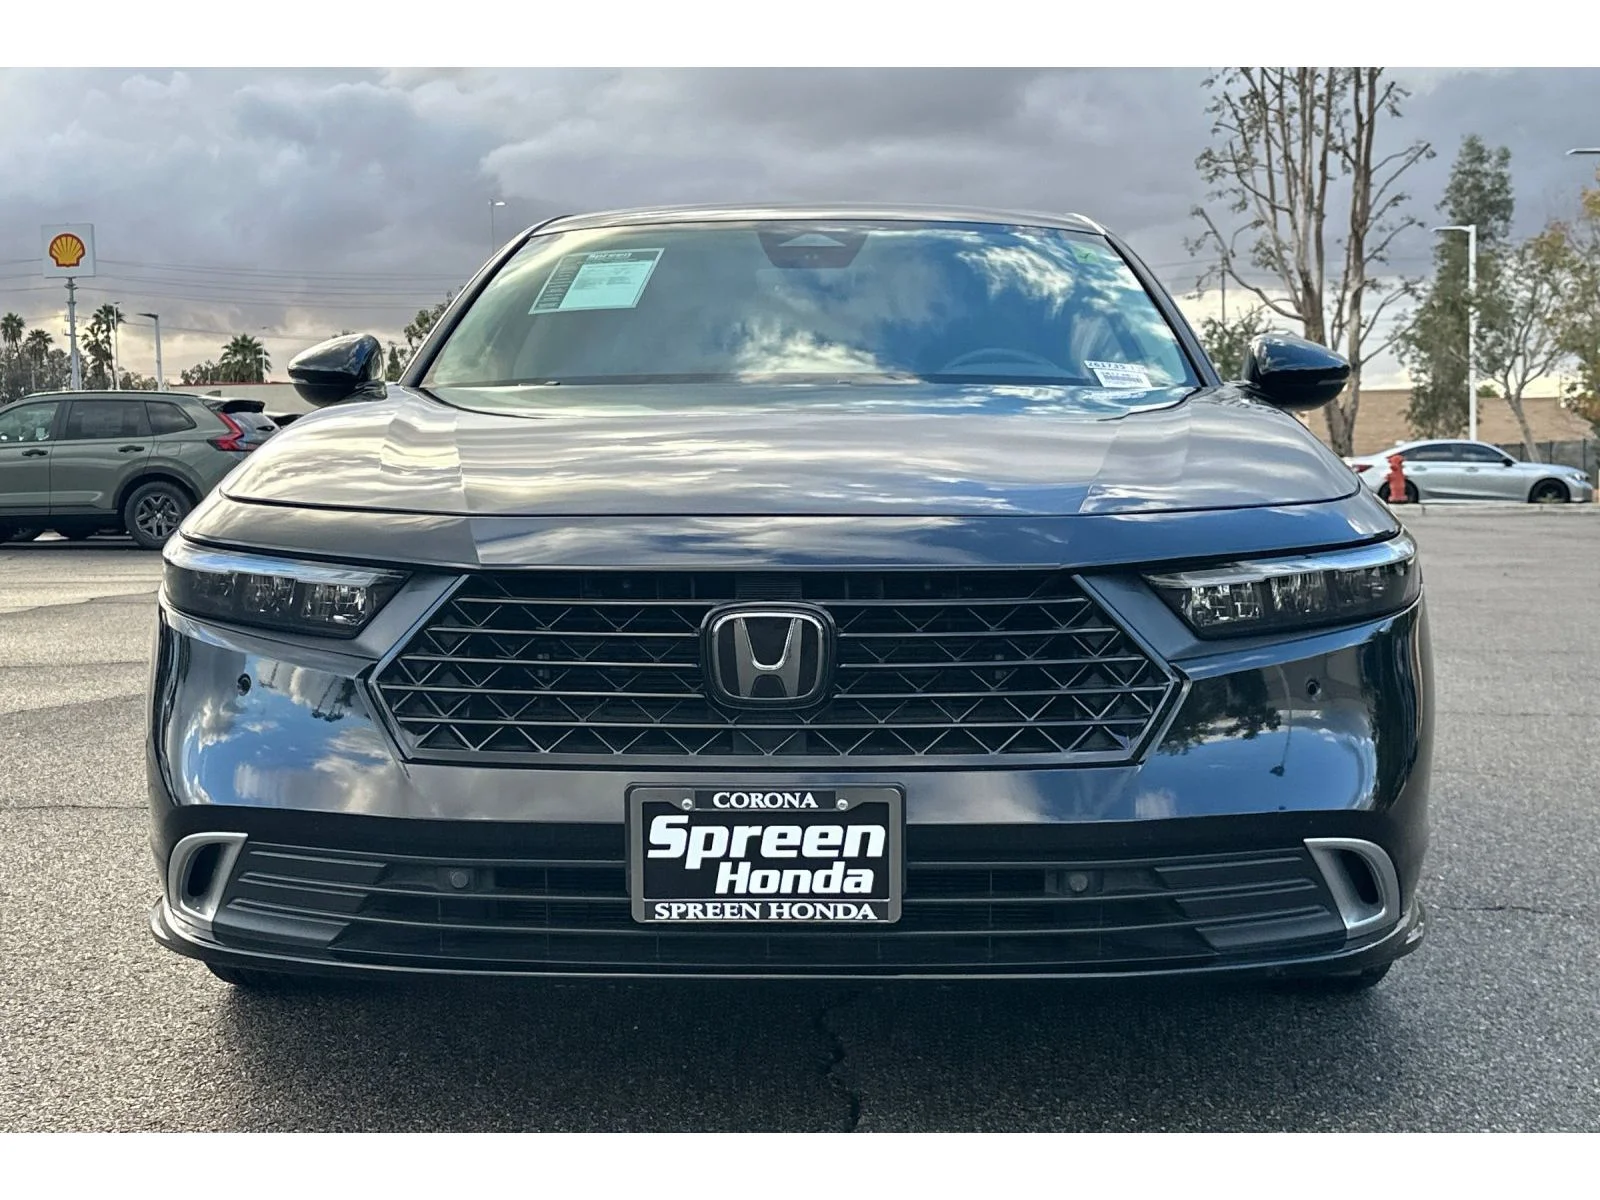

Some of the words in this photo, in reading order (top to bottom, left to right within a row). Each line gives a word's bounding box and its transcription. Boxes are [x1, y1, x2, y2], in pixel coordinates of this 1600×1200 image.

[712, 791, 819, 809] CORONA
[647, 814, 886, 870] Spreen
[714, 861, 875, 895] Honda
[654, 902, 761, 920] SPREEN
[767, 902, 878, 920] HONDA
